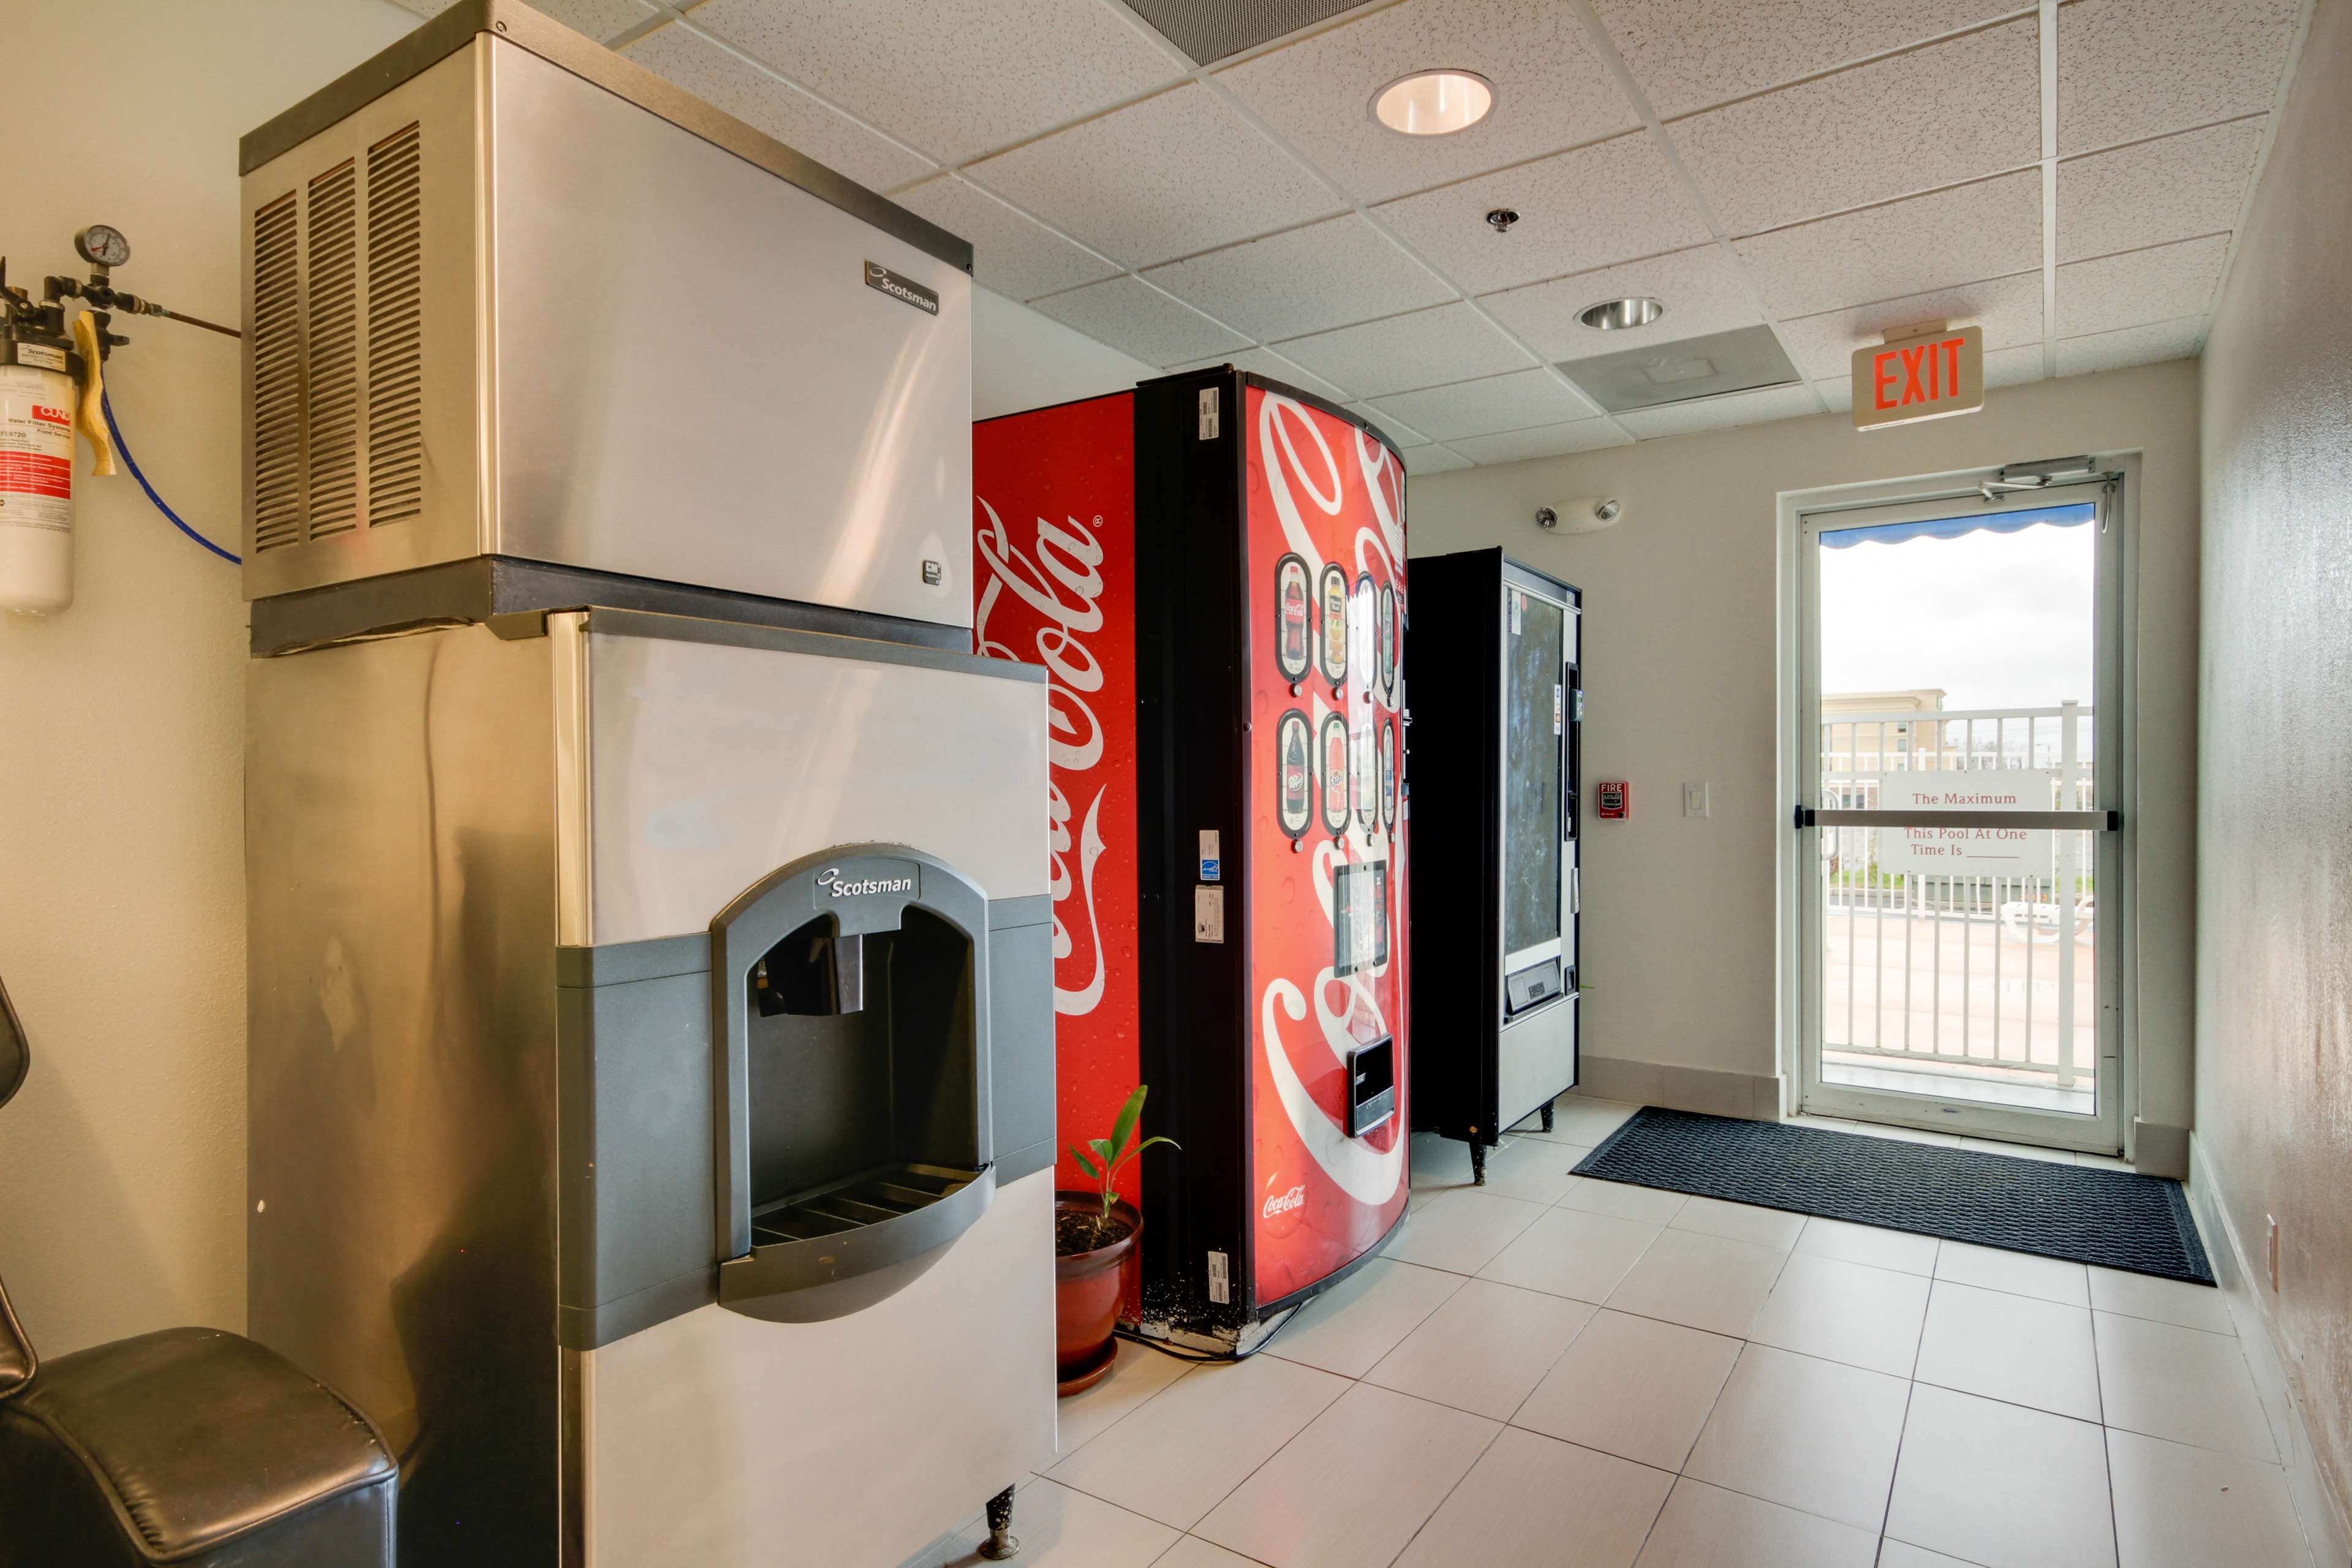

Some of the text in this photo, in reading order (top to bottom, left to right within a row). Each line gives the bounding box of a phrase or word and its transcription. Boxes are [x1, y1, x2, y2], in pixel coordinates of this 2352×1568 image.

[882, 277, 937, 311] Scotsman
[28, 348, 64, 360] Scotsman
[1874, 337, 1965, 410] EXIT
[1912, 793, 2016, 804] The Maximum
[1904, 827, 2027, 840] This Pool At One
[1911, 843, 1962, 856] Time Is
[831, 878, 911, 897] Scotsman
